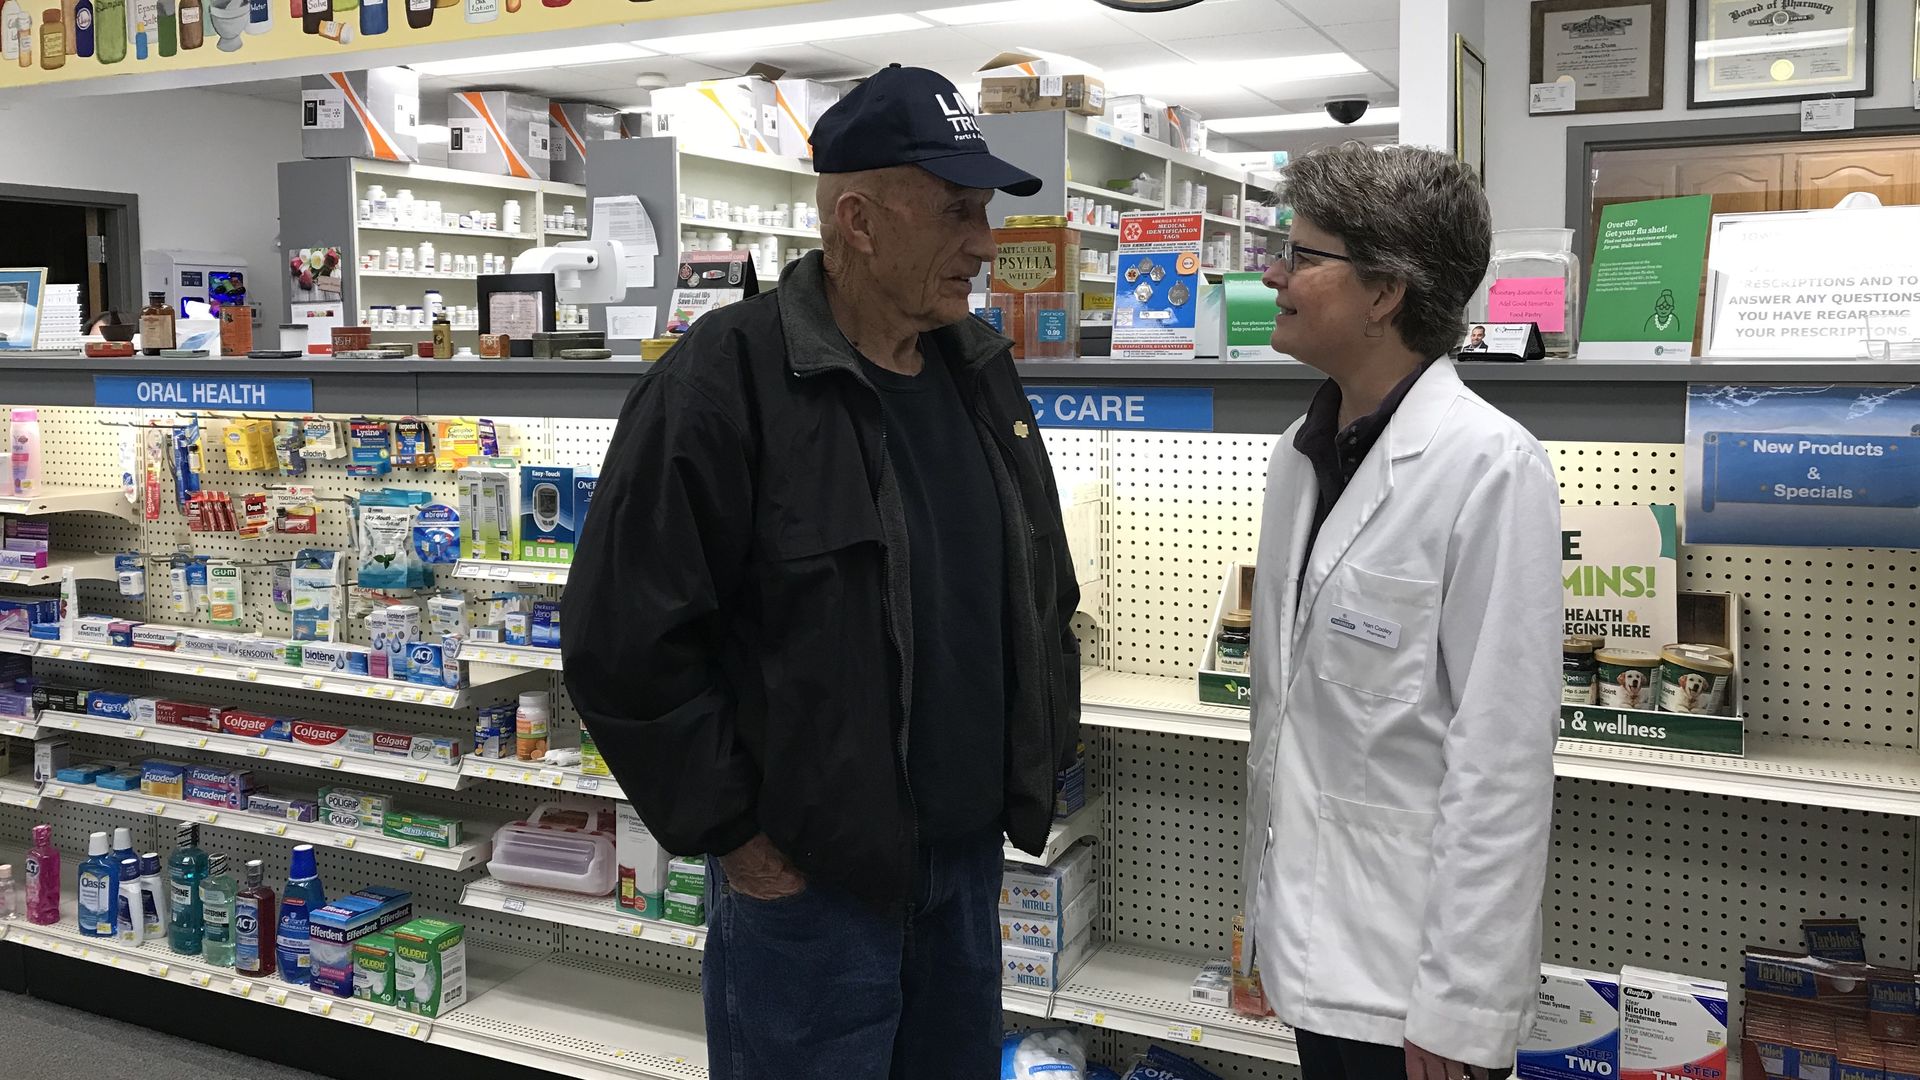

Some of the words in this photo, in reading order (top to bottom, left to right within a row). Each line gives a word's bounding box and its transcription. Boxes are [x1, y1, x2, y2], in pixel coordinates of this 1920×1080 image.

[1729, 4, 1763, 23] Board
[1767, 0, 1777, 9] of
[1781, 0, 1834, 14] Pharmacy
[1606, 221, 1625, 229] Over
[1624, 219, 1638, 227] 65?
[1605, 230, 1618, 238] Get
[1618, 229, 1637, 238] your
[1636, 227, 1647, 235] flu
[1647, 225, 1668, 234] shot!
[999, 256, 1052, 270] PSYLLA
[1009, 272, 1042, 280] WHITE
[1743, 276, 1856, 290] RESCRIPTIONS
[1859, 276, 1893, 287] AND
[1898, 275, 1918, 286] TO
[1728, 294, 1794, 305] ANSWER
[1796, 293, 1827, 304] ANY
[1831, 292, 1920, 304] QUESTIONS
[1738, 311, 1768, 322] YOU
[1772, 310, 1811, 321] HAVE
[1735, 327, 1776, 338] YOUR
[136, 381, 188, 403] ORAL
[192, 382, 266, 405] HEALTH
[1054, 394, 1146, 422] CARE
[1753, 440, 1794, 454] New
[1798, 440, 1884, 457] Products
[1807, 466, 1821, 480] &
[1773, 484, 1854, 500] Specials
[1564, 608, 1623, 622] HEALTH
[1626, 609, 1638, 623] &
[81, 624, 102, 632] Crest
[1362, 620, 1374, 629] Nan
[1374, 623, 1393, 636] Cooley
[1611, 623, 1651, 638] HERE
[133, 631, 166, 641] parodontax
[238, 649, 274, 660] SENSODYN
[414, 650, 432, 661] ACT
[156, 715, 176, 723] WHITE
[224, 715, 267, 730] Colgate
[1571, 710, 1588, 732] &
[1593, 713, 1668, 740] wellness
[294, 724, 338, 741] Colgate
[376, 734, 409, 747] Colgate
[414, 743, 432, 752] Total
[144, 771, 179, 785] Fixodent
[193, 770, 227, 784] Fixodent
[191, 788, 228, 802] Fixodent
[248, 800, 280, 811] Fixodent
[328, 796, 359, 809] POLIGRIP
[331, 813, 359, 826] POLIGRIP
[81, 877, 106, 890] Oasis
[1021, 898, 1051, 912] NITRILE
[379, 906, 411, 926] Efferdent
[236, 917, 257, 931] ACT
[346, 920, 379, 942] Efferdent
[310, 924, 344, 943] Efferdent
[1808, 931, 1861, 949] Tarblock
[1022, 934, 1051, 949] NITRILE
[398, 945, 429, 961] POLIDENT
[358, 957, 386, 970] POLIDENT
[1017, 973, 1047, 988] NITRILE
[1757, 963, 1804, 986] Tarblock
[380, 993, 392, 1002] 40
[1626, 987, 1650, 999] Rugby
[1871, 984, 1915, 1002] Tarblock
[421, 1003, 432, 1013] 84
[1552, 1001, 1571, 1010] System
[1625, 998, 1640, 1006] Clear
[1625, 1004, 1662, 1018] Nicotine
[1624, 1016, 1641, 1025] Patch
[1625, 1011, 1657, 1023] Transdermal
[1657, 1017, 1678, 1027] System
[1624, 1027, 1639, 1035] STOP
[1640, 1030, 1664, 1041] SMOKING
[1576, 1045, 1614, 1061] STEP
[1564, 1054, 1613, 1076] TWO
[1683, 1062, 1720, 1079] STEP
